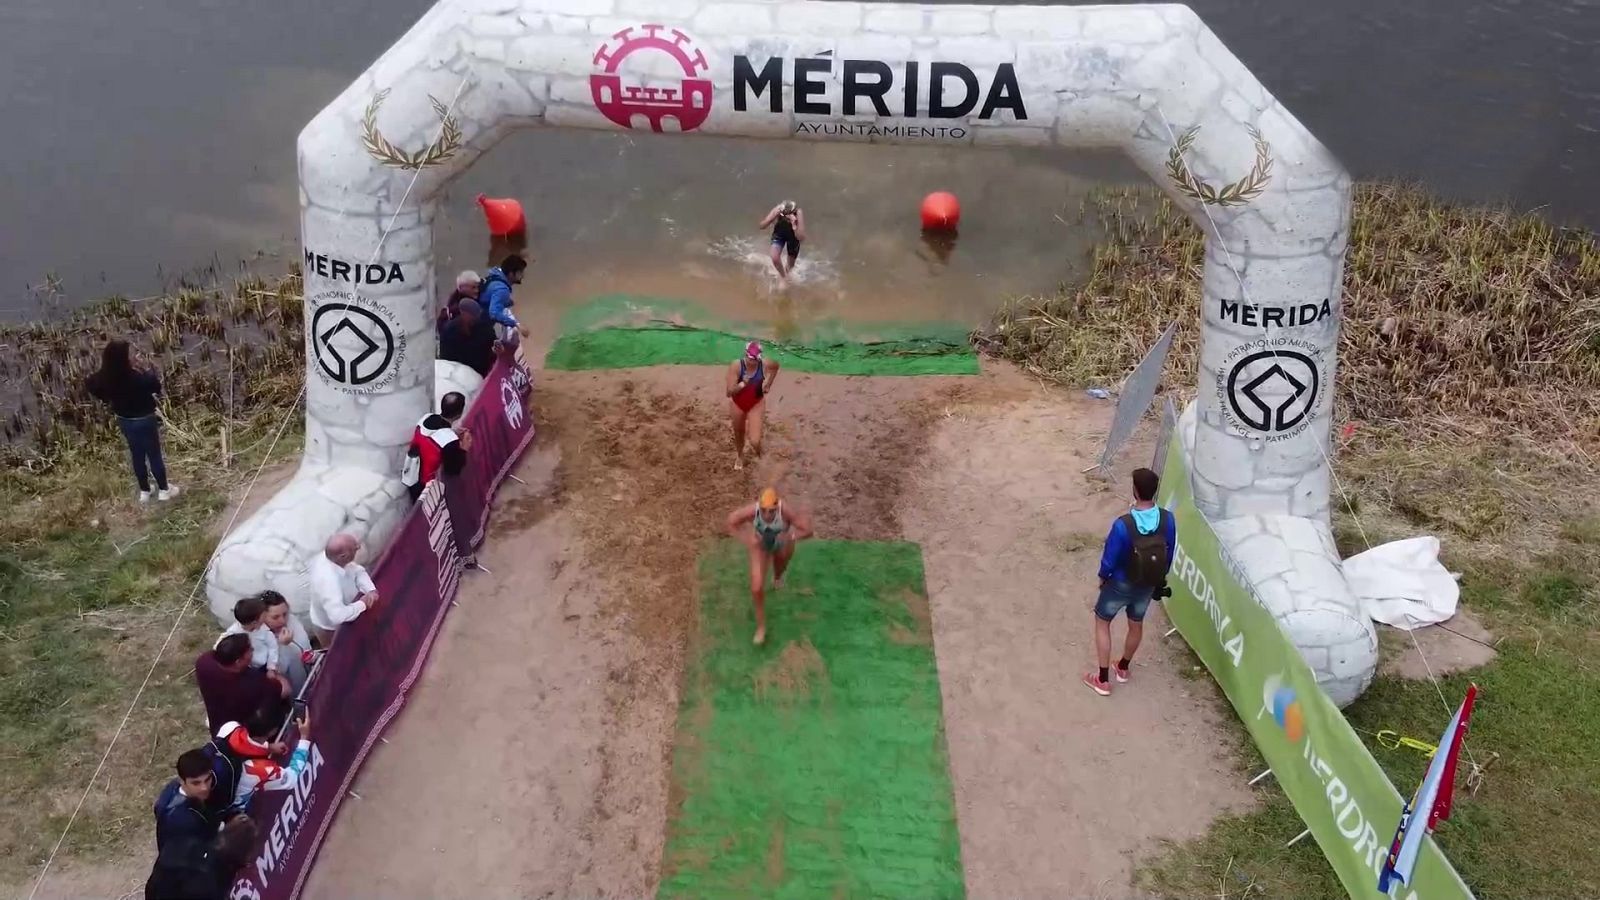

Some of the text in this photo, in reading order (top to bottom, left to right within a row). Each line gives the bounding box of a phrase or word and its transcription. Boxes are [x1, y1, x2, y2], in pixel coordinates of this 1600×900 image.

[733, 49, 1028, 121] MÉRIDA
[795, 121, 966, 140] AYUNTAMIENTO
[304, 247, 405, 284] MÉRIDA
[1173, 543, 1244, 668] ERDROLA
[255, 742, 325, 889] MÉRIDA
